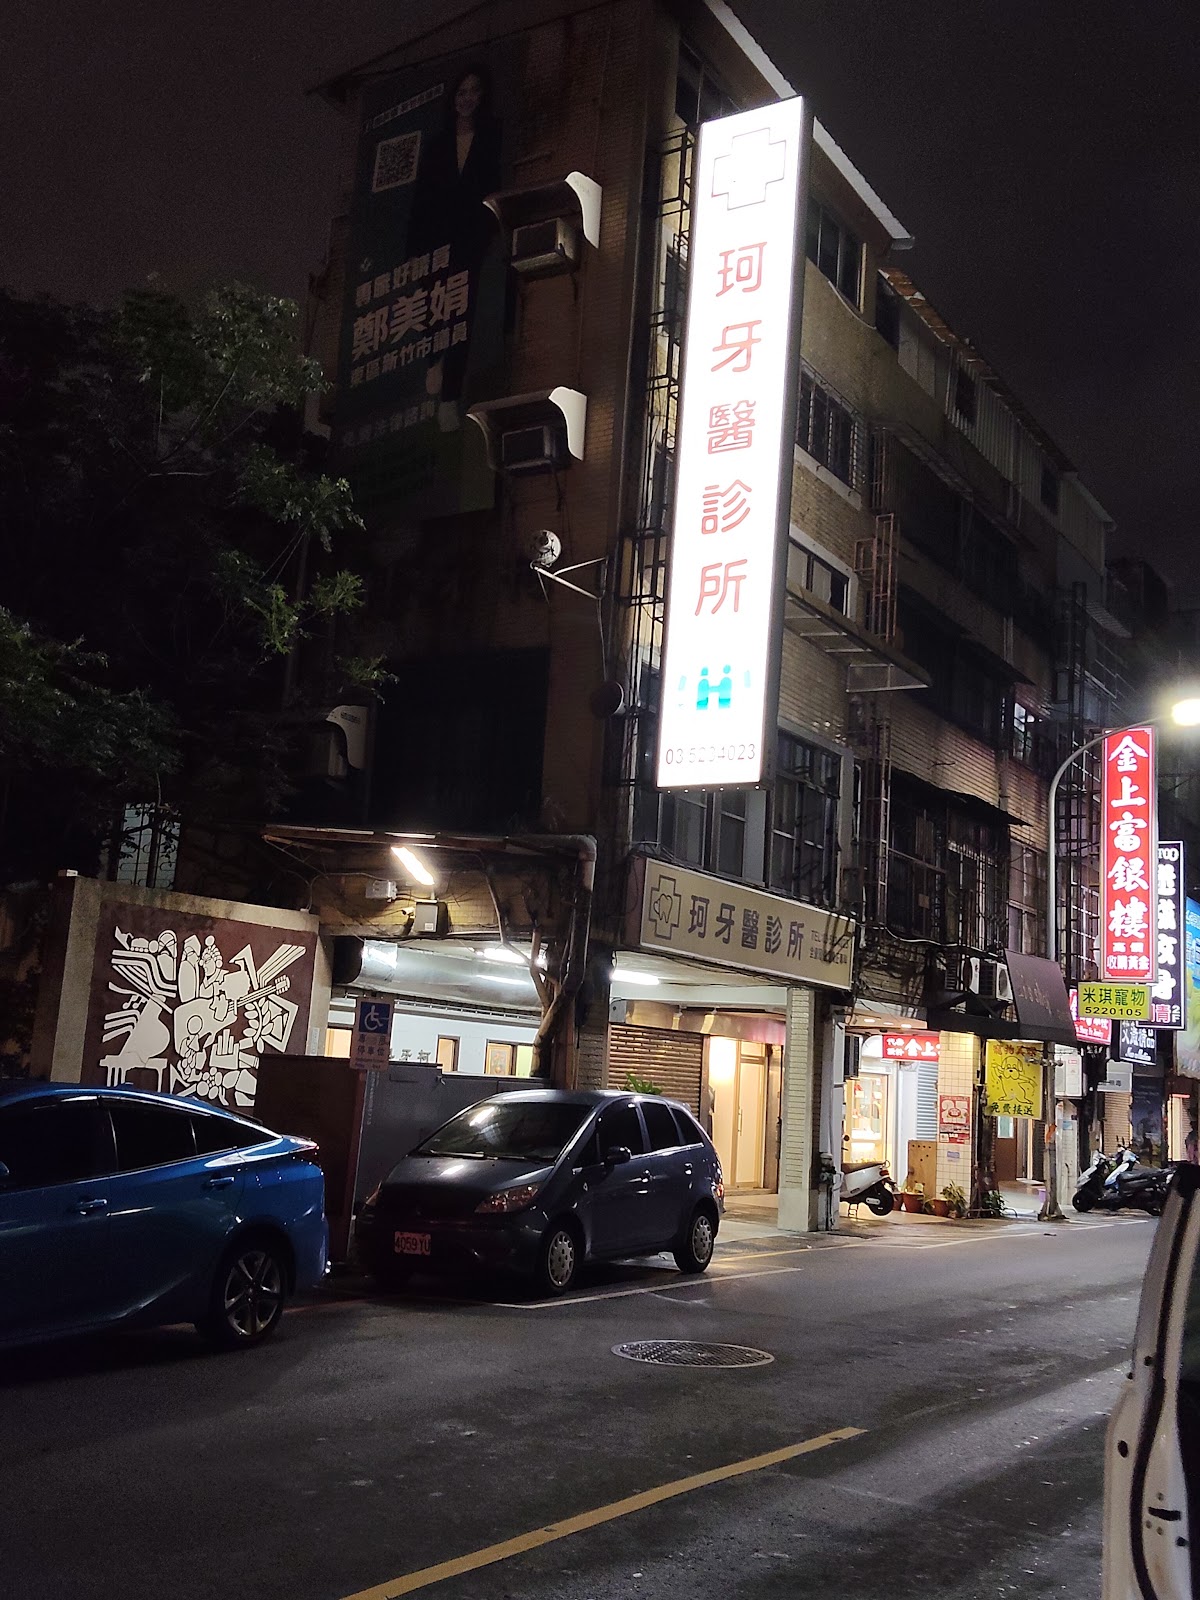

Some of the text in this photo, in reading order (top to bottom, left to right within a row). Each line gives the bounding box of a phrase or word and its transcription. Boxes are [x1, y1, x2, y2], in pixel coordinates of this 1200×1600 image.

[351, 269, 470, 362] 鄭美娟
[695, 242, 768, 616] 珂牙醫診所
[1107, 735, 1149, 939] 金上富銀樓
[687, 894, 805, 961] 珂牙醫診所
[1107, 955, 1149, 970] 收購黃金
[1082, 987, 1146, 1006] 米琪寵物
[1085, 1006, 1142, 1017] 5220105
[904, 1038, 941, 1057] 金上
[941, 1099, 969, 1124] 25
[991, 1102, 1034, 1117] 免費接送
